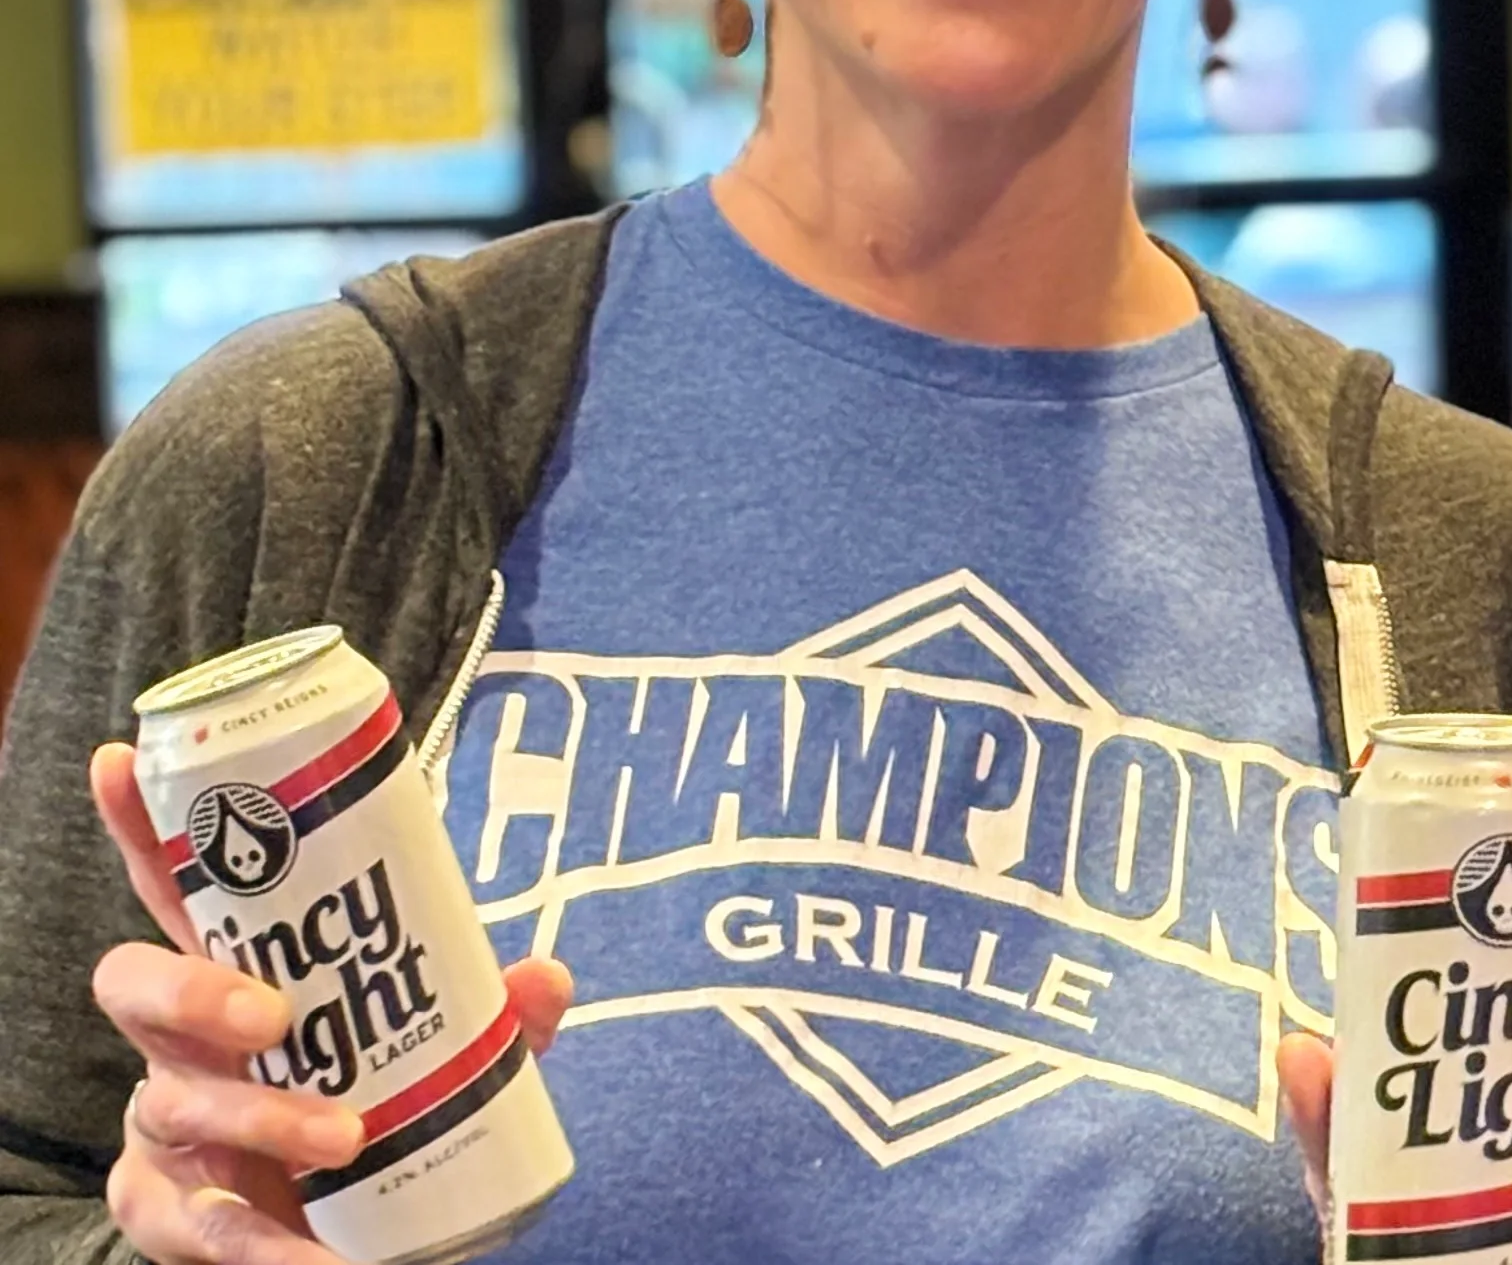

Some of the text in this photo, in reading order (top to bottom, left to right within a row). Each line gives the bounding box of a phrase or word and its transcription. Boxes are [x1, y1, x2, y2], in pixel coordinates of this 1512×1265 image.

[444, 672, 1340, 1018] CHAMPIONS
[703, 894, 1113, 1034] GRILLE
[368, 1011, 446, 1074] LAGER
